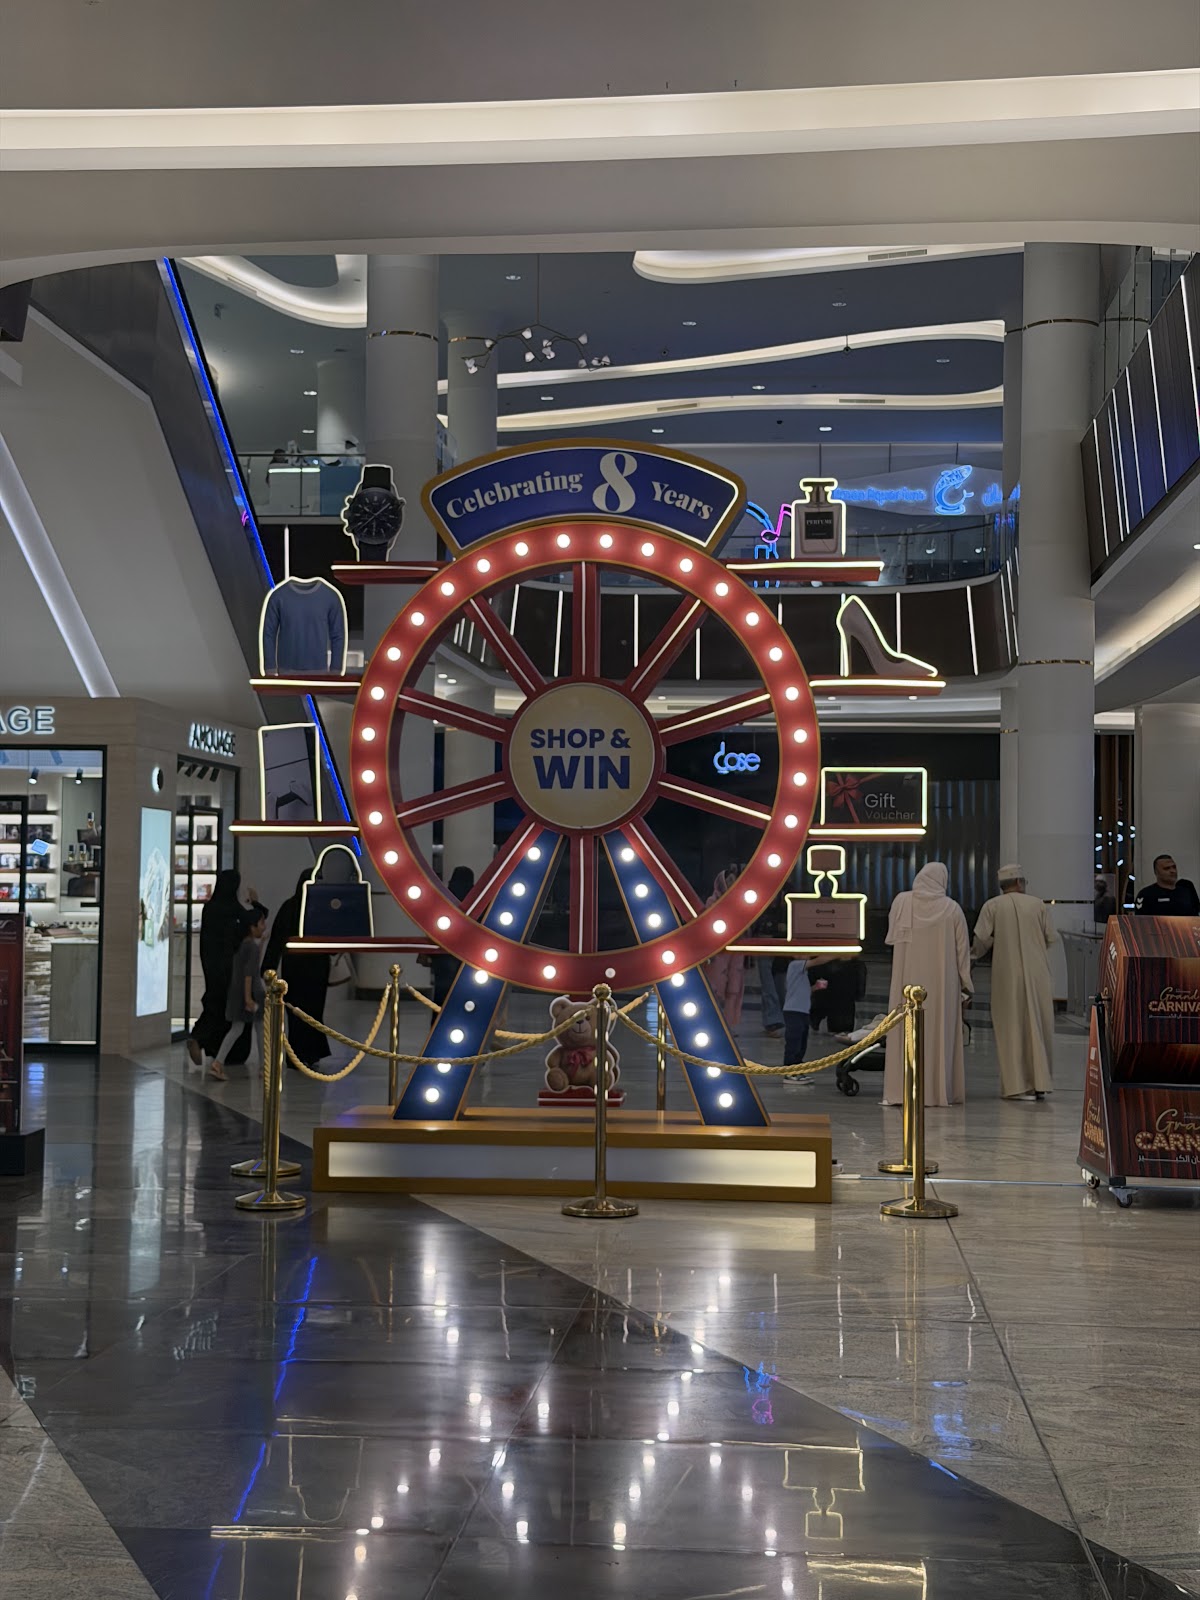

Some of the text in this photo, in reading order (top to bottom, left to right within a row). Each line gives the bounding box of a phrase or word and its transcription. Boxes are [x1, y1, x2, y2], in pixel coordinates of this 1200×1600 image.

[446, 452, 714, 520] Celebrating 8 Years
[0, 705, 55, 735] GE
[530, 728, 631, 749] SHOP &
[532, 755, 630, 789] WIN
[864, 793, 896, 808] Gift
[865, 810, 915, 820] Voucher
